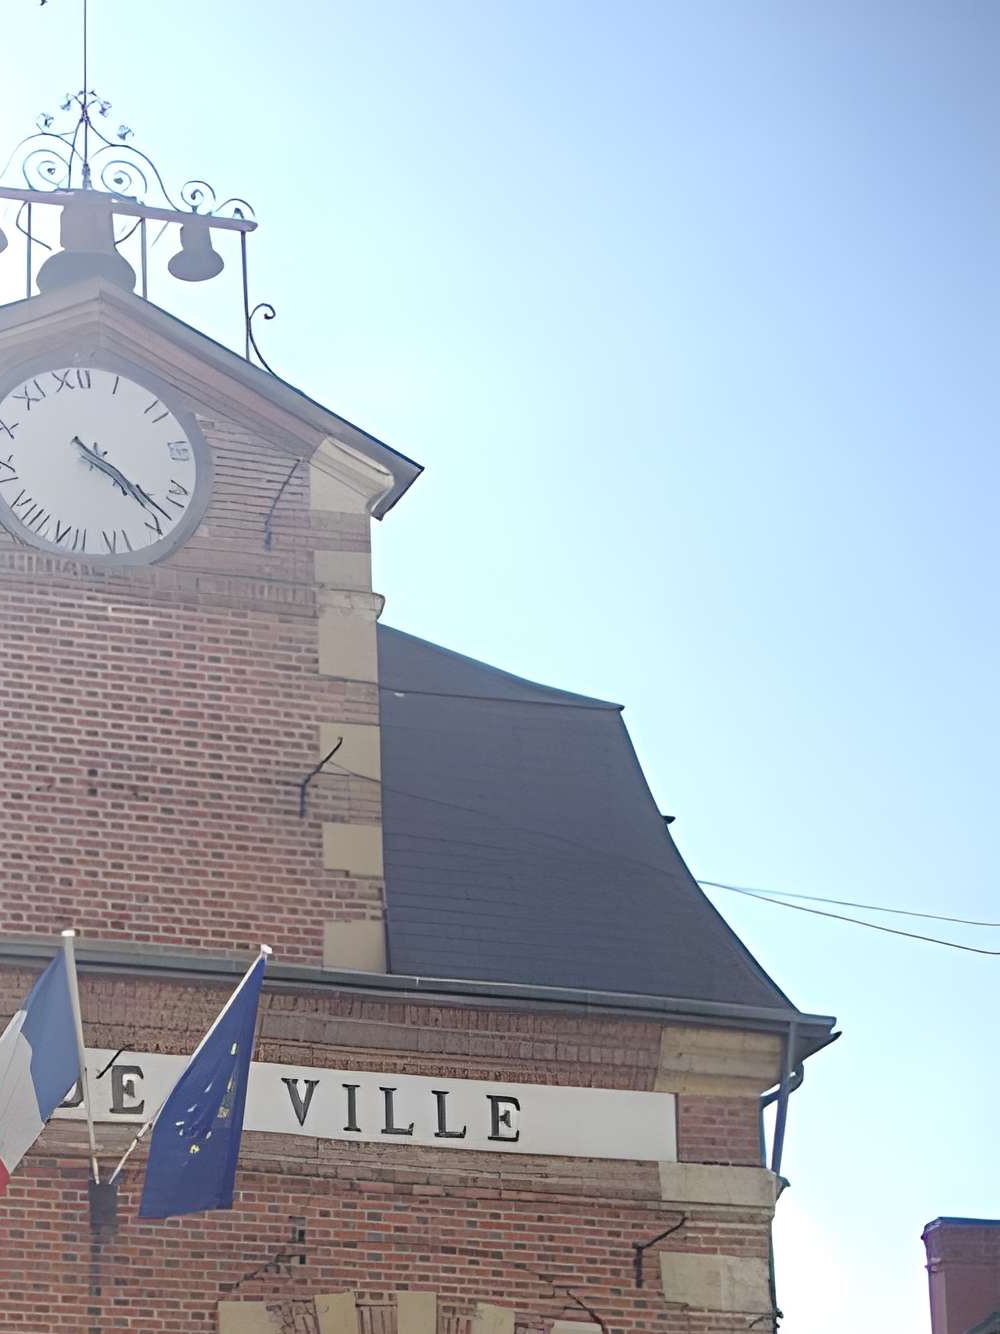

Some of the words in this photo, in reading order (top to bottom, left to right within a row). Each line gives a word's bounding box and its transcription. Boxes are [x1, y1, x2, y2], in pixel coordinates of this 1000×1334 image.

[12, 379, 46, 411] XI
[51, 369, 91, 392] XII
[10, 489, 51, 534] VIII
[56, 520, 87, 552] VII
[102, 529, 133, 554] VI
[280, 1077, 521, 1143] VILLE
